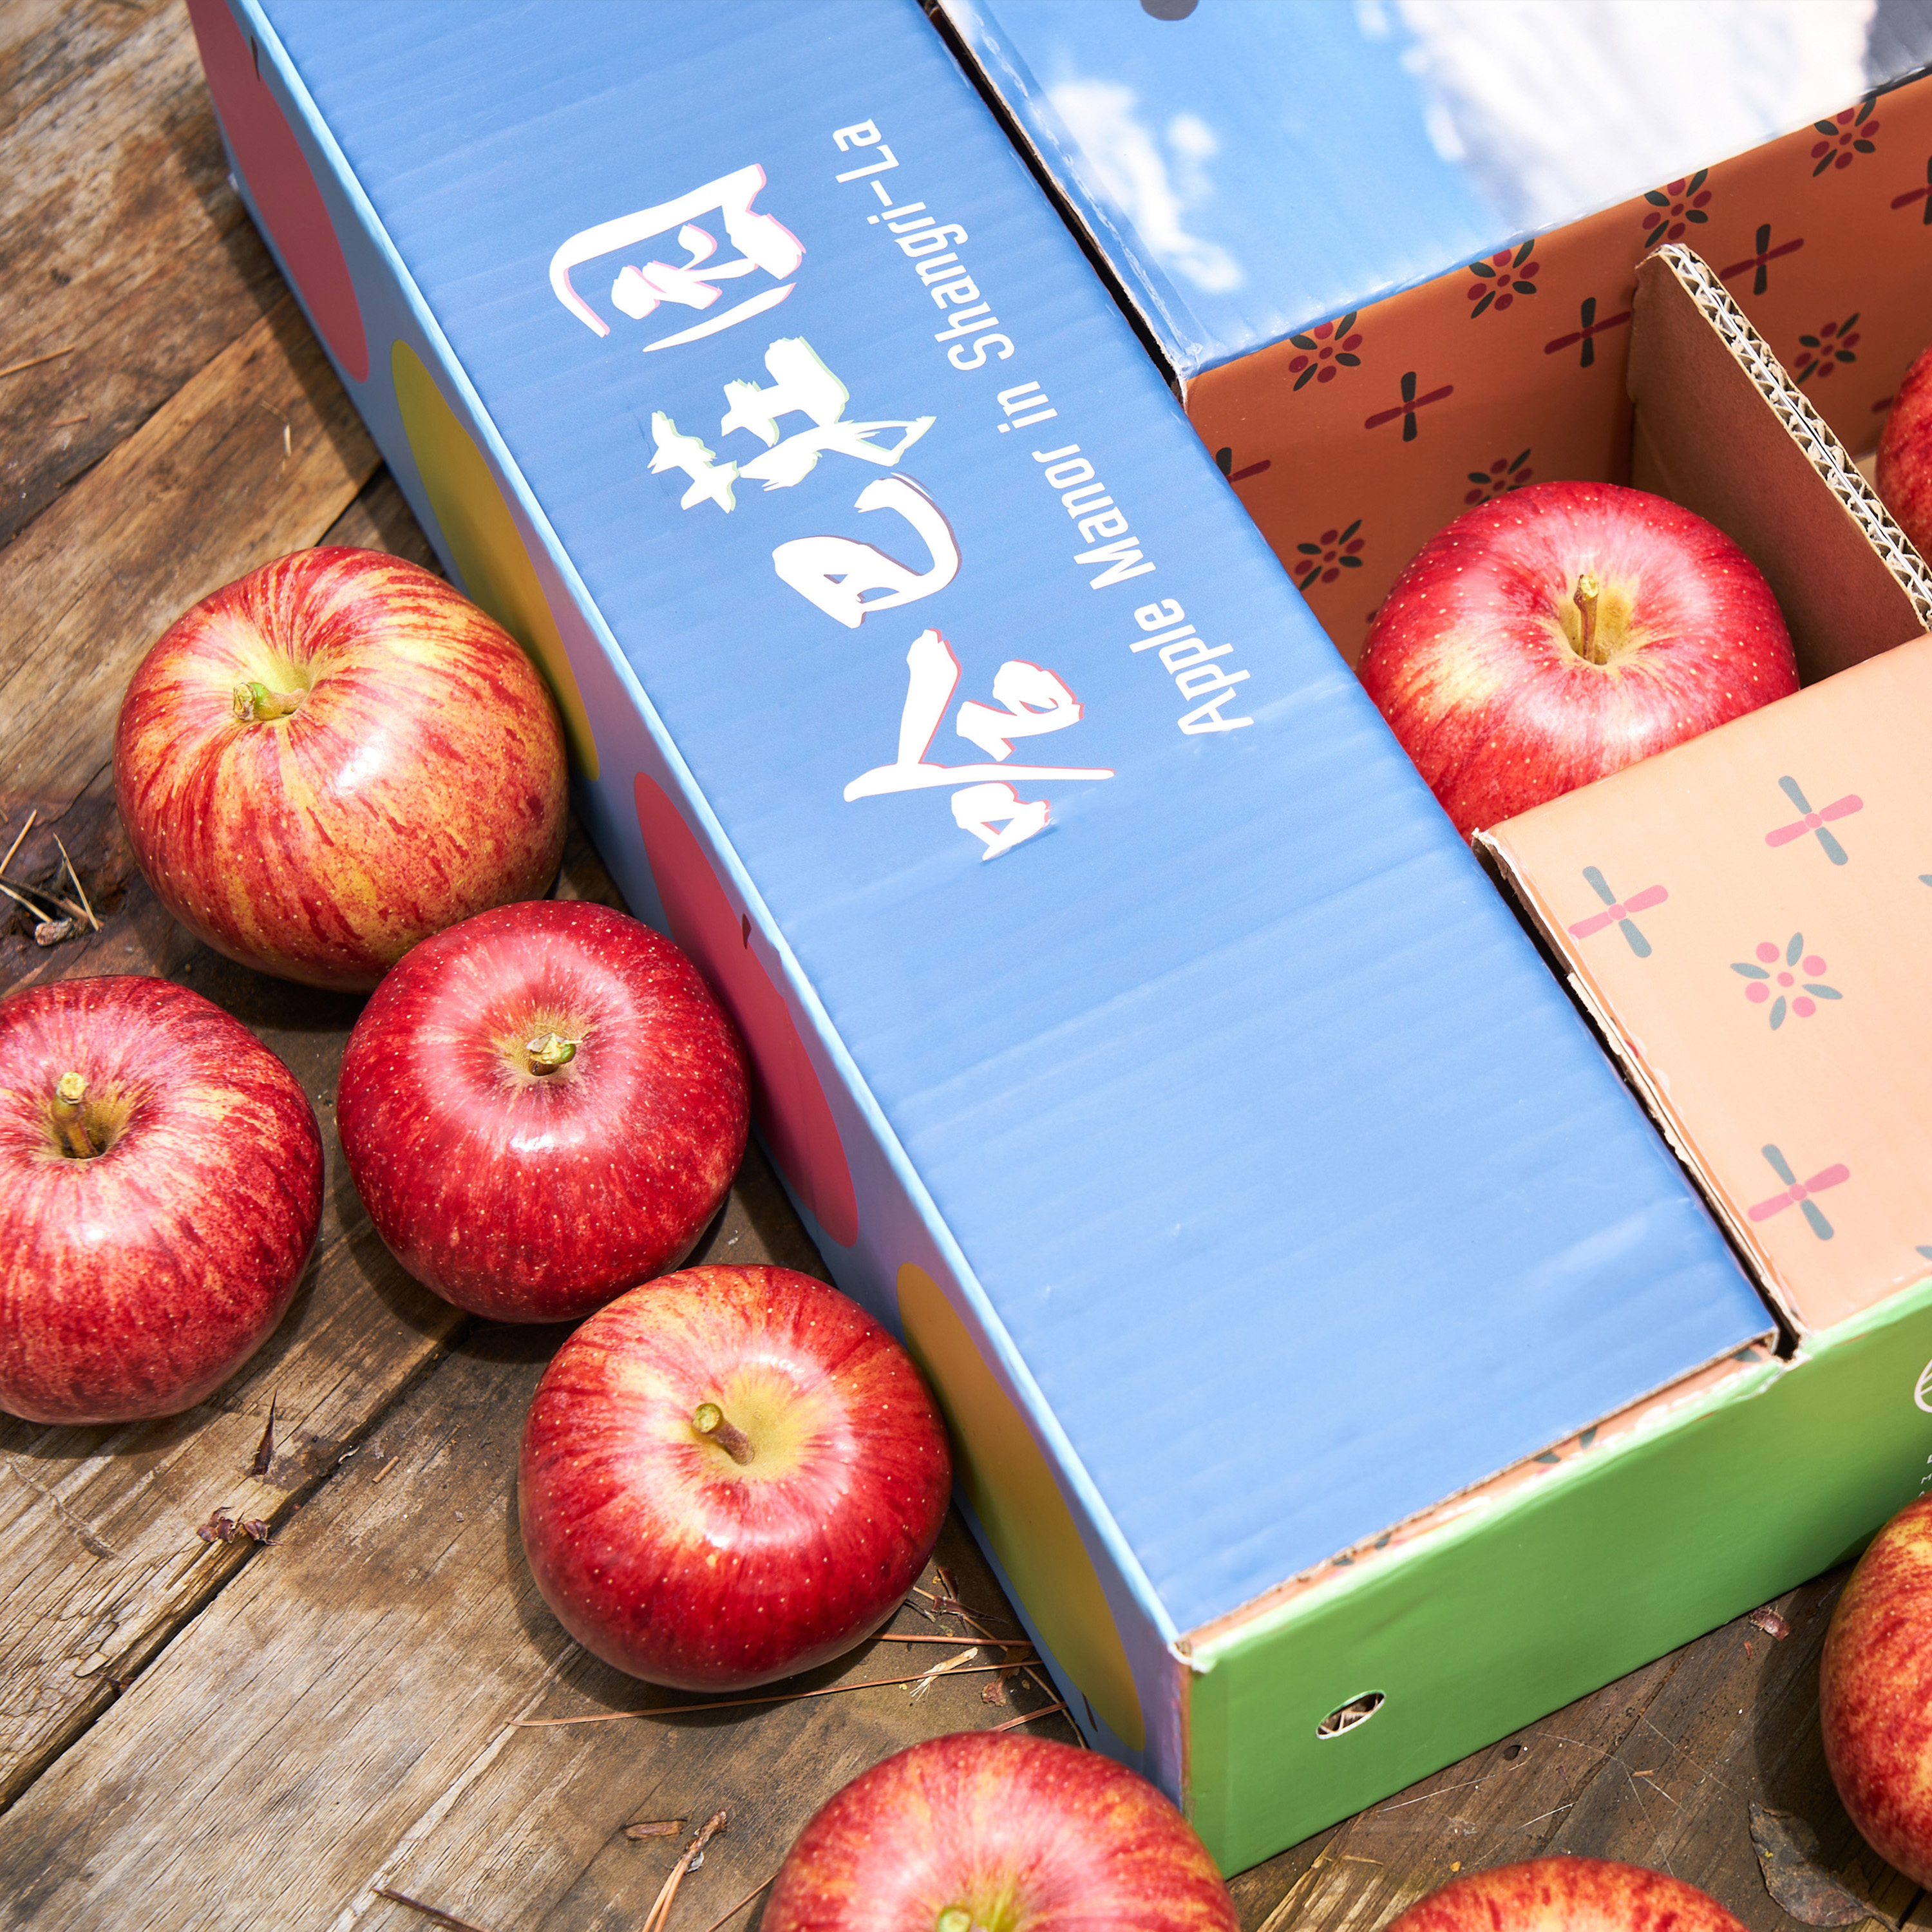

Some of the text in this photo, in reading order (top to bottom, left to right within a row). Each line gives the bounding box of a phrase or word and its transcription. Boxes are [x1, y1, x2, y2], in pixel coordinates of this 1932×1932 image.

[833, 118, 1255, 735] Apple Manor in Shangri-La
